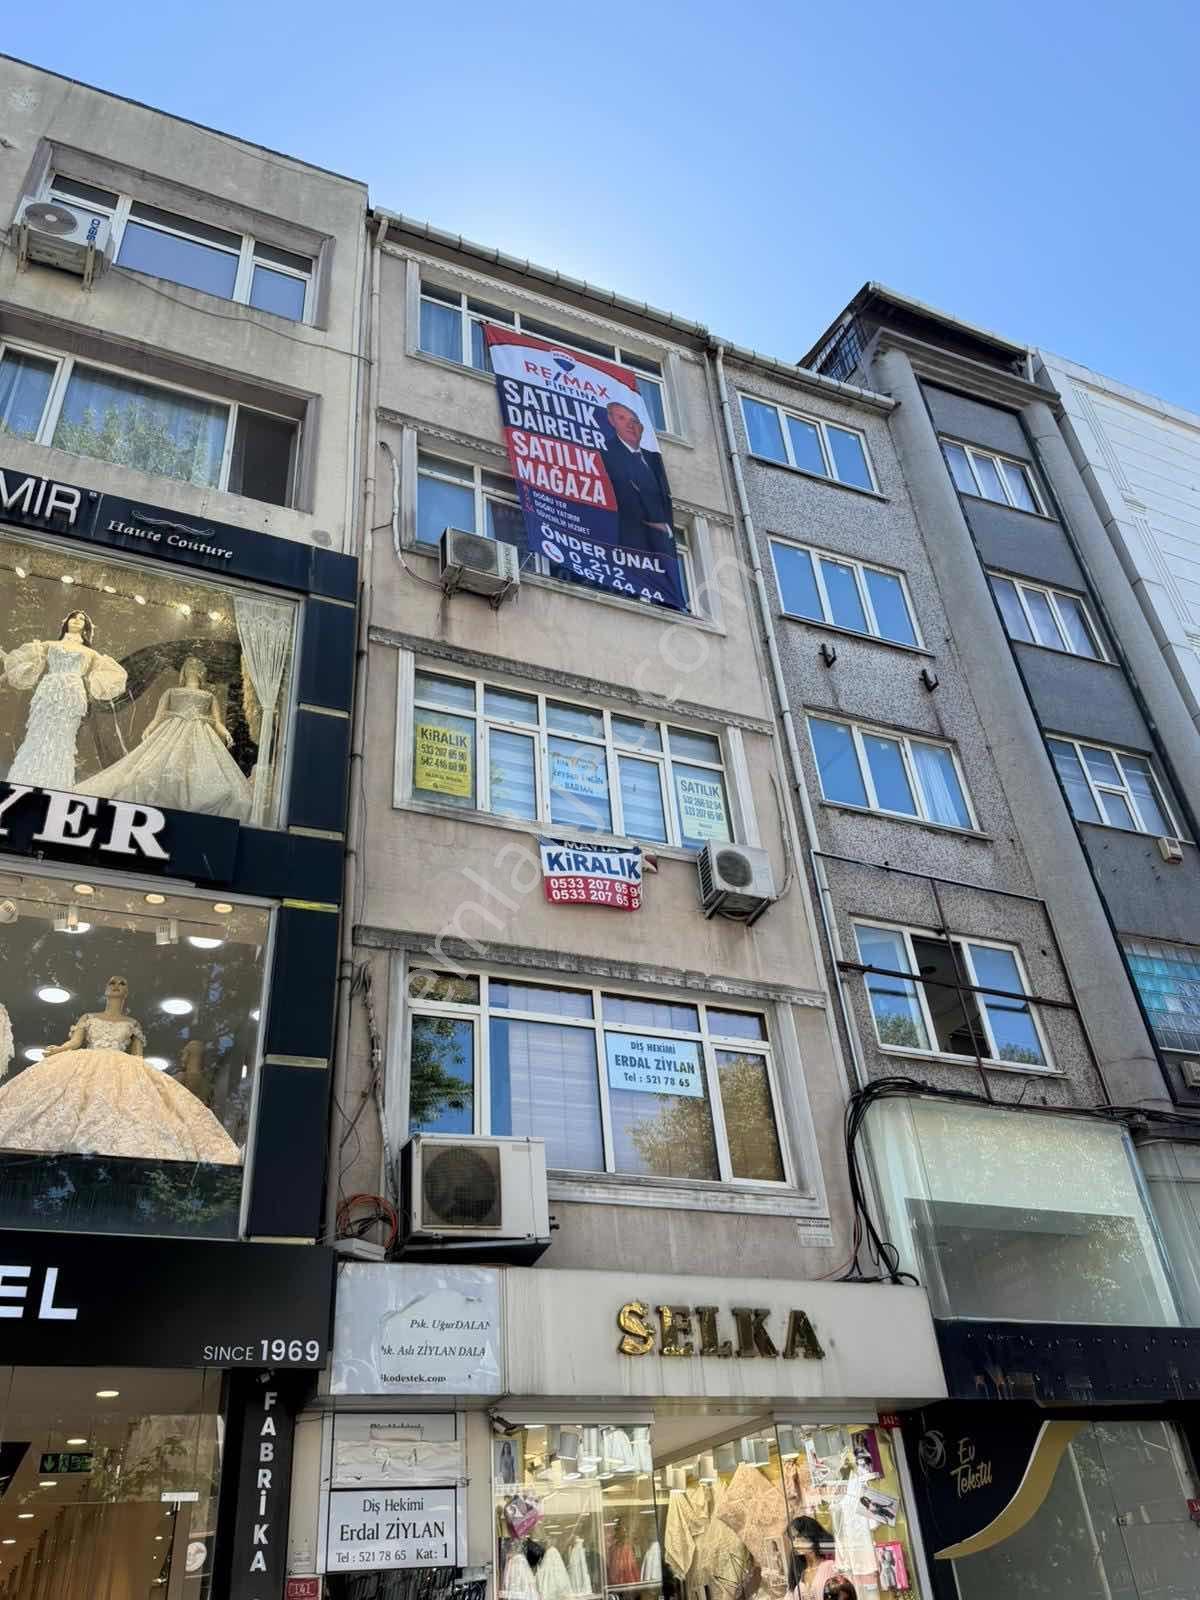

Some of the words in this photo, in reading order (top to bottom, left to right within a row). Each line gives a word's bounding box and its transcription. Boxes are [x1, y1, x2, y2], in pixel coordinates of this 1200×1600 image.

[503, 379, 600, 429] SATILIK
[507, 404, 608, 451] DAİRELER
[511, 431, 600, 476] SATILIK
[516, 457, 607, 506] MAĞAZA
[107, 519, 162, 543] Haute
[166, 534, 233, 559] Couture
[541, 522, 607, 561] ÖNDER
[612, 547, 666, 574] ÜNAL
[589, 559, 626, 580] 212
[572, 563, 604, 584] 567
[612, 579, 636, 594] 44
[640, 588, 664, 602] 44
[681, 779, 721, 800] SATILIK
[550, 878, 584, 889] 0533
[588, 879, 610, 890] 207
[615, 881, 628, 894] 65
[552, 889, 586, 900] 0533
[590, 890, 612, 902] 207
[616, 894, 629, 906] 65
[614, 1054, 651, 1069] ERDAL
[654, 1056, 695, 1074] ZİYLAN
[624, 1072, 637, 1082] Tel
[646, 1075, 661, 1085] 521
[664, 1076, 676, 1086] 78
[679, 1079, 690, 1087] 65
[410, 1319, 429, 1329] Psk.
[617, 1300, 826, 1360] SELKA
[203, 1345, 255, 1361] SINCE
[260, 1338, 320, 1362] 1969
[381, 1345, 395, 1355] sk.
[417, 1340, 456, 1356] ZİYLAN
[957, 1437, 976, 1465] Ev
[950, 1460, 993, 1498] Tekstil
[363, 1499, 381, 1515] Diş
[384, 1497, 424, 1513] Hekimi
[340, 1522, 380, 1541] Erdal
[385, 1517, 445, 1540] ZİYLAN
[336, 1551, 349, 1563] Tel
[359, 1551, 376, 1563] 521
[379, 1550, 392, 1562] 78
[394, 1550, 407, 1561] 65
